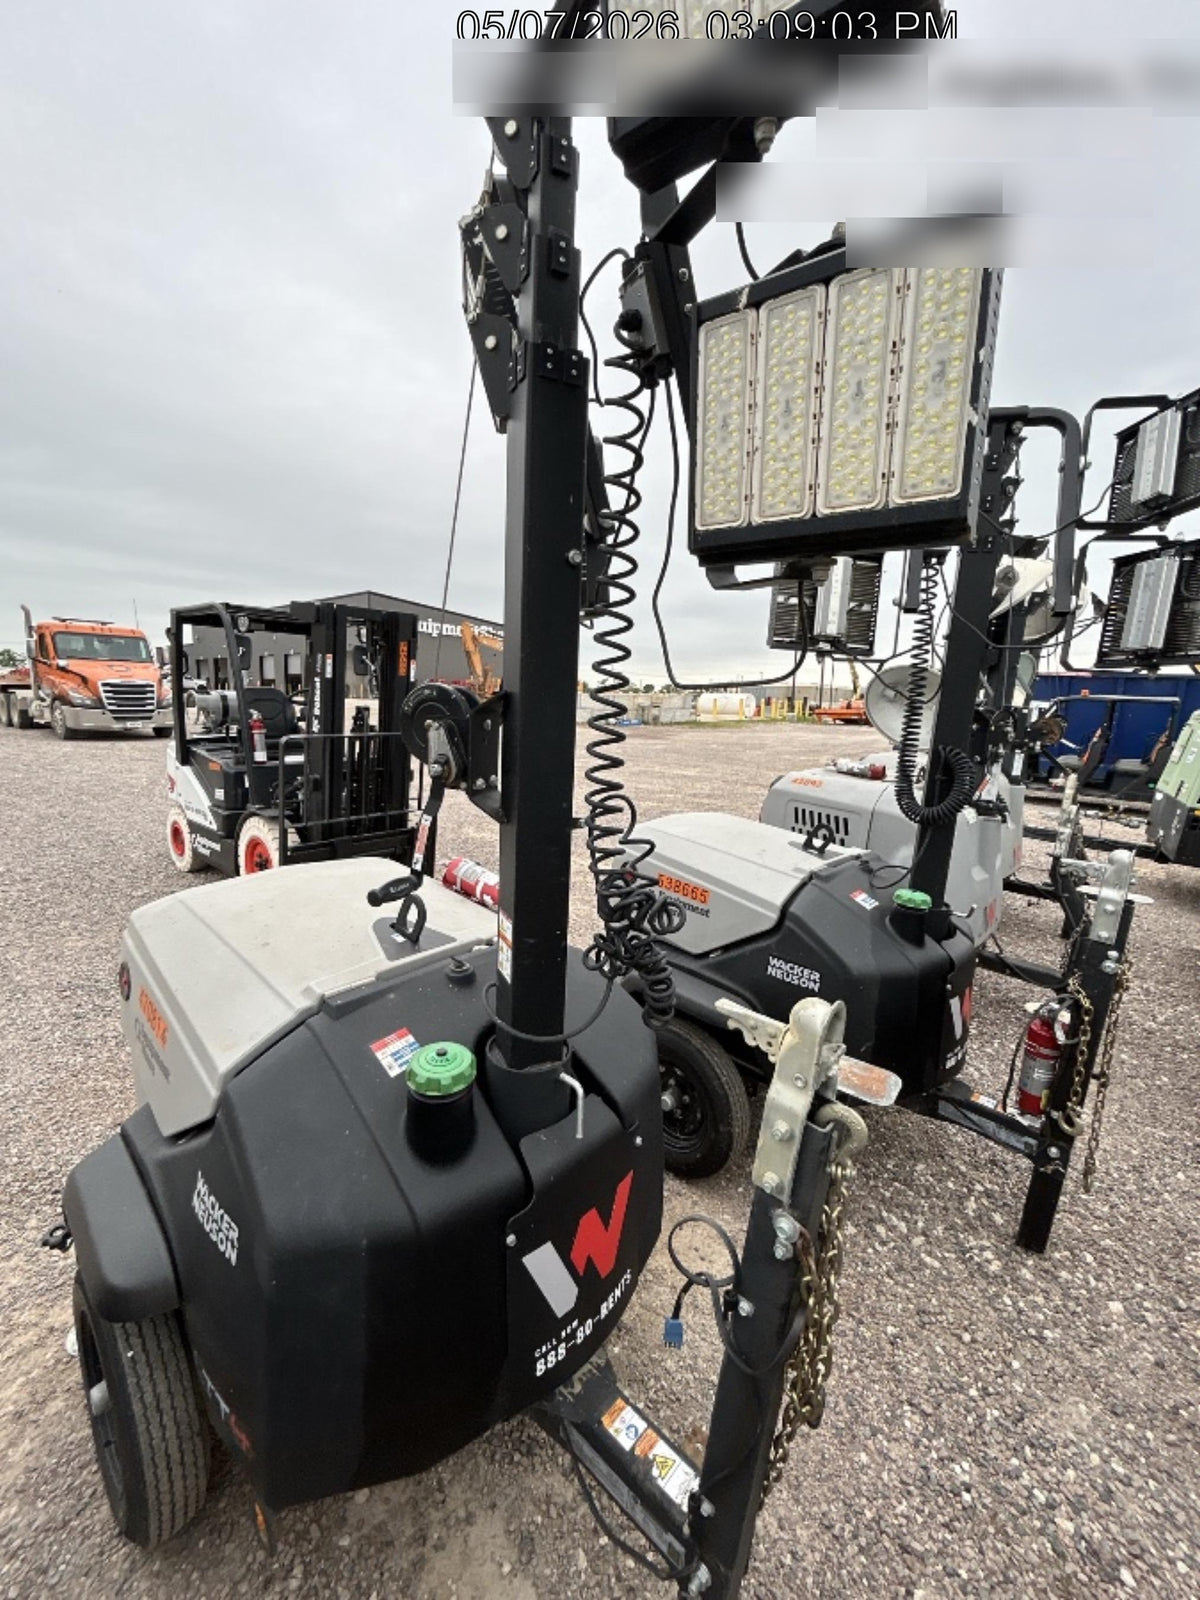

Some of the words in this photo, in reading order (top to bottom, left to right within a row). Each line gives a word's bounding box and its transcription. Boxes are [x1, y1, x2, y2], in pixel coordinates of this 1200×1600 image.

[766, 965, 820, 993] NEUSON
[769, 955, 821, 982] WACKER
[192, 1187, 238, 1267] NEUSON
[197, 1169, 239, 1249] WACKER
[534, 1337, 558, 1358] CALL
[535, 1268, 632, 1377] 888-80-RENTS
